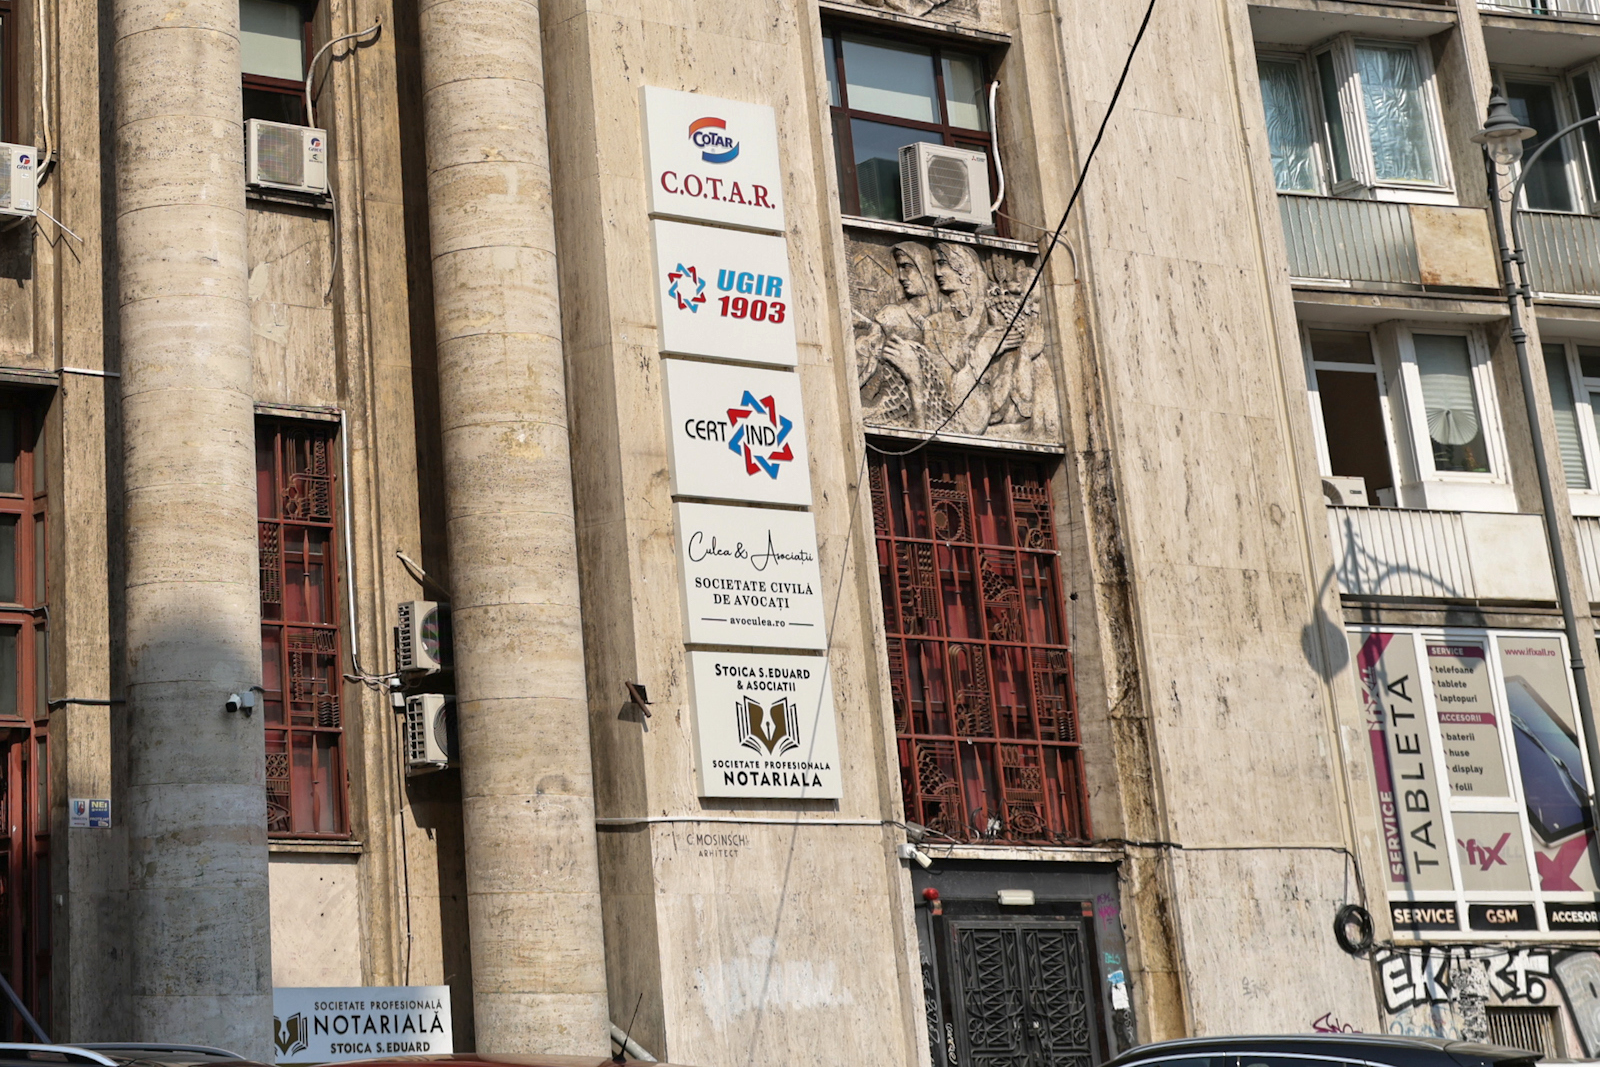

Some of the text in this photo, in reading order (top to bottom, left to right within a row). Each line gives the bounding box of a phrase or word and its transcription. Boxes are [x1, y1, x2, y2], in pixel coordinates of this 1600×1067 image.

[660, 170, 776, 210] C.O.T.A.R.
[717, 269, 784, 298] UGIR
[718, 295, 786, 324] 1903
[685, 418, 776, 447] CERT IND
[688, 530, 732, 562] Culea
[734, 541, 749, 560] &
[695, 576, 767, 593] SOCIETATE
[713, 593, 790, 612] DE AVOCAȚI
[730, 616, 786, 628] avoculea.ro
[1431, 647, 1464, 656] SERVICE
[1504, 647, 1556, 657] www.ifixall.ro
[714, 663, 811, 680] STOICA S.EDUARD
[1435, 665, 1474, 675] telefoane
[736, 680, 796, 692] & ASOCIATII
[1437, 680, 1467, 689] tablete
[1439, 694, 1478, 704] laptopuri
[1440, 713, 1482, 723] ACCESORII
[1446, 733, 1475, 742] baterii
[1449, 748, 1470, 757] huse
[712, 759, 831, 771] SOCIETATE PROFESIONALA
[1452, 764, 1484, 775] display
[723, 770, 823, 788] NOTARIALA
[1387, 674, 1440, 875] TABLETA
[1455, 782, 1474, 792] folii
[1380, 790, 1406, 876] SERVICE
[698, 849, 739, 858] ARHITECT
[1393, 908, 1600, 924] SERVICE GSM ACCESOR
[314, 1001, 366, 1011] SOCIETATE
[313, 1010, 445, 1035] NOTARIALĂ
[330, 1041, 431, 1055] STOICA S.EDUARD
